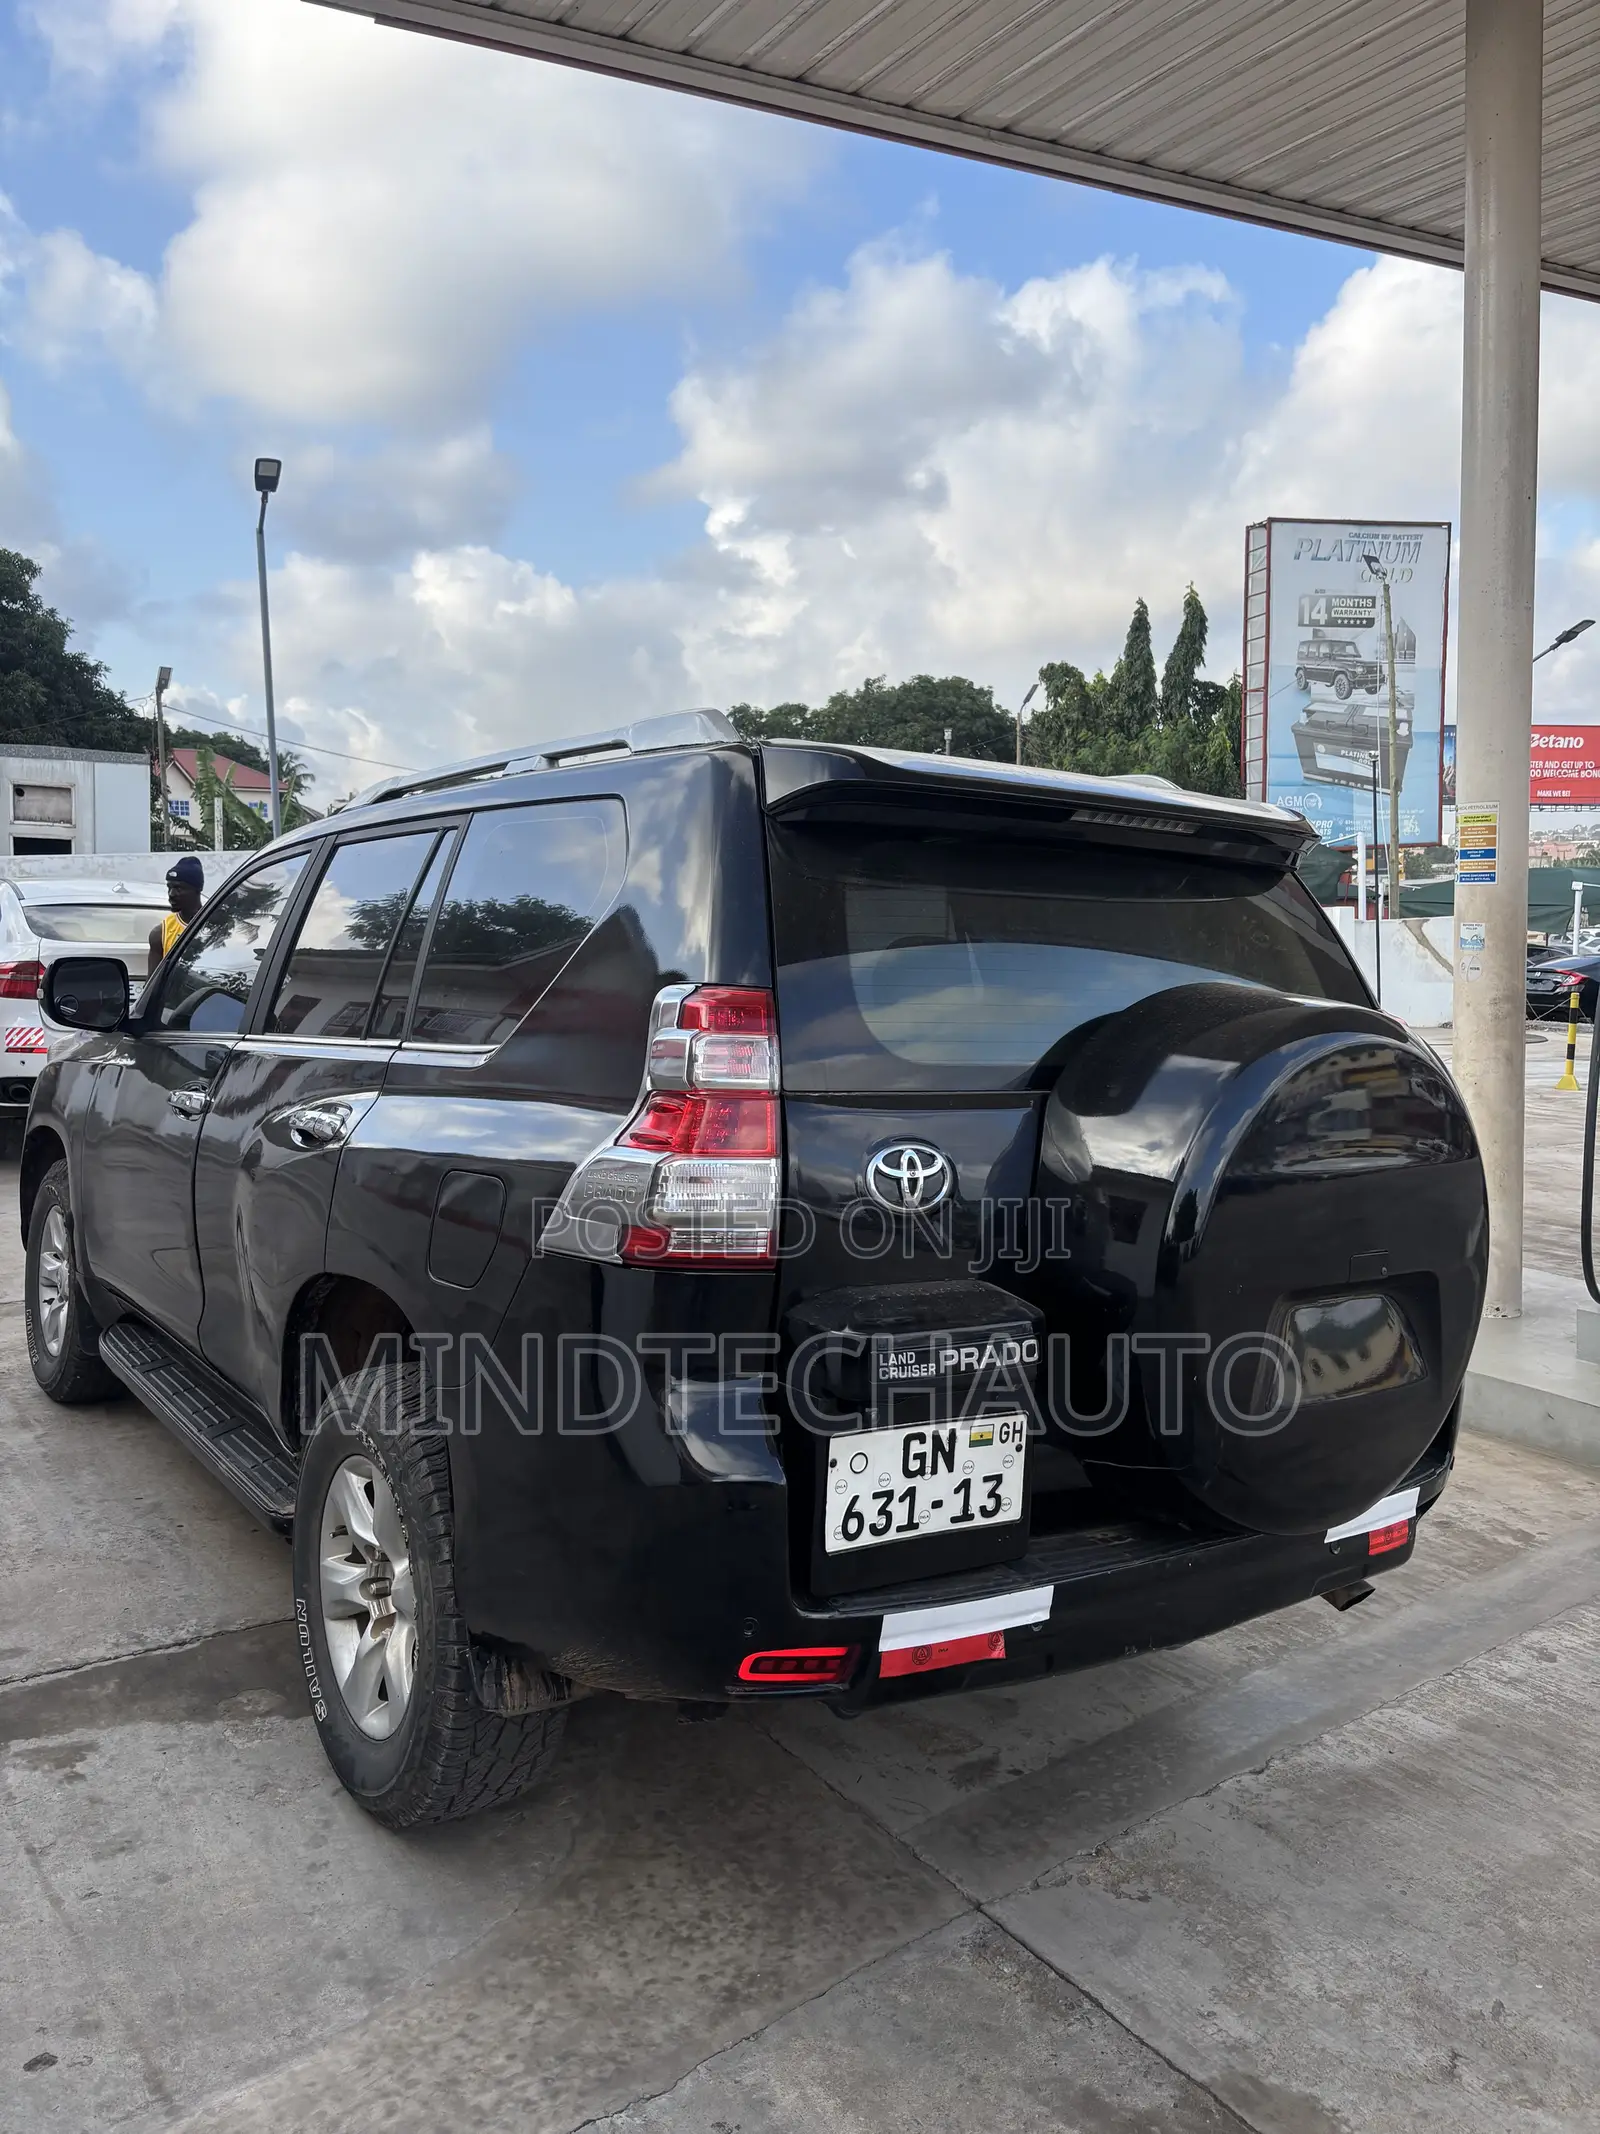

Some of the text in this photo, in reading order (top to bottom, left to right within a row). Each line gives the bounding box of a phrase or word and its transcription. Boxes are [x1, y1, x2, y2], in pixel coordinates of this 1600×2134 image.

[1348, 532, 1380, 540] CALCIUM
[1293, 538, 1422, 564] PLATINUM
[1300, 596, 1328, 626] 14
[1331, 598, 1373, 608] MONTHS
[1530, 733, 1585, 749] Betano
[1544, 761, 1560, 769] AND
[1561, 761, 1573, 769] GET
[1574, 761, 1583, 769] UP
[1584, 761, 1595, 769] TO
[1542, 769, 1579, 778] WELCOME
[1537, 789, 1552, 797] MAKE
[1276, 796, 1302, 807] AGM
[607, 1171, 639, 1183] CRUISER
[583, 1181, 637, 1204] PRADO
[879, 1351, 915, 1367] LAND
[939, 1339, 1039, 1374] PRADO
[879, 1363, 936, 1380] CRUISER
[902, 1421, 1024, 1478] GN GH
[841, 1473, 1003, 1541] 631-13
[295, 1598, 328, 1722] SAILUN
